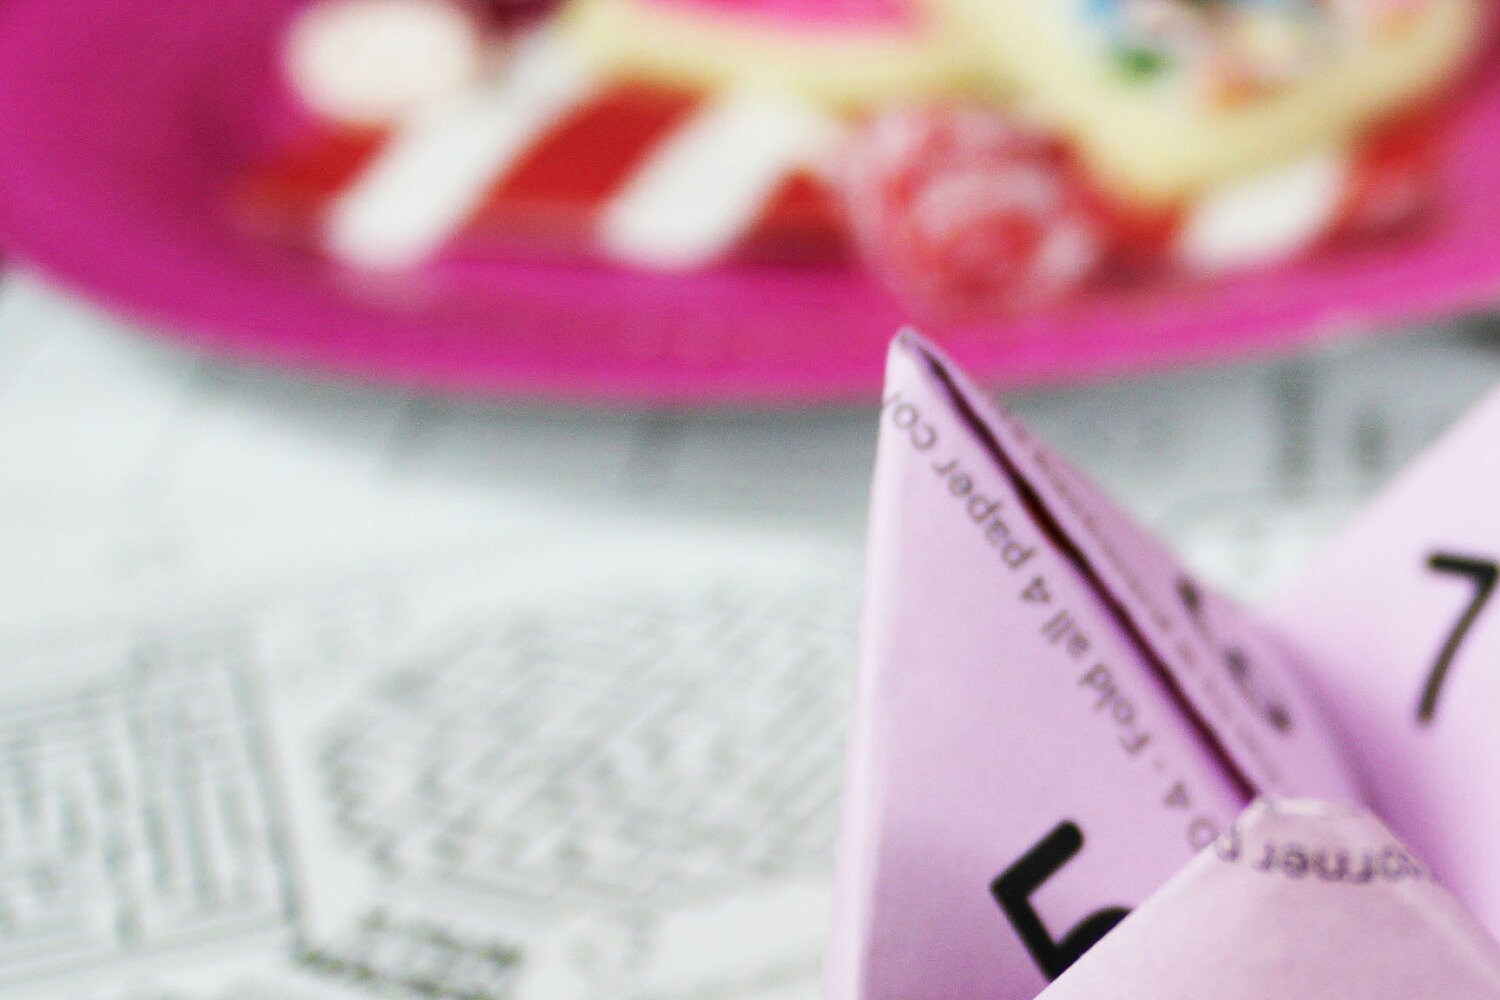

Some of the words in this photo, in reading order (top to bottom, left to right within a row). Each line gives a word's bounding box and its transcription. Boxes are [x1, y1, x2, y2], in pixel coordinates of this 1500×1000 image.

[933, 456, 1036, 571] paper
[1020, 574, 1053, 607] 4
[1041, 608, 1092, 659] all
[1078, 663, 1152, 755] Fold
[989, 818, 1132, 980] 5
